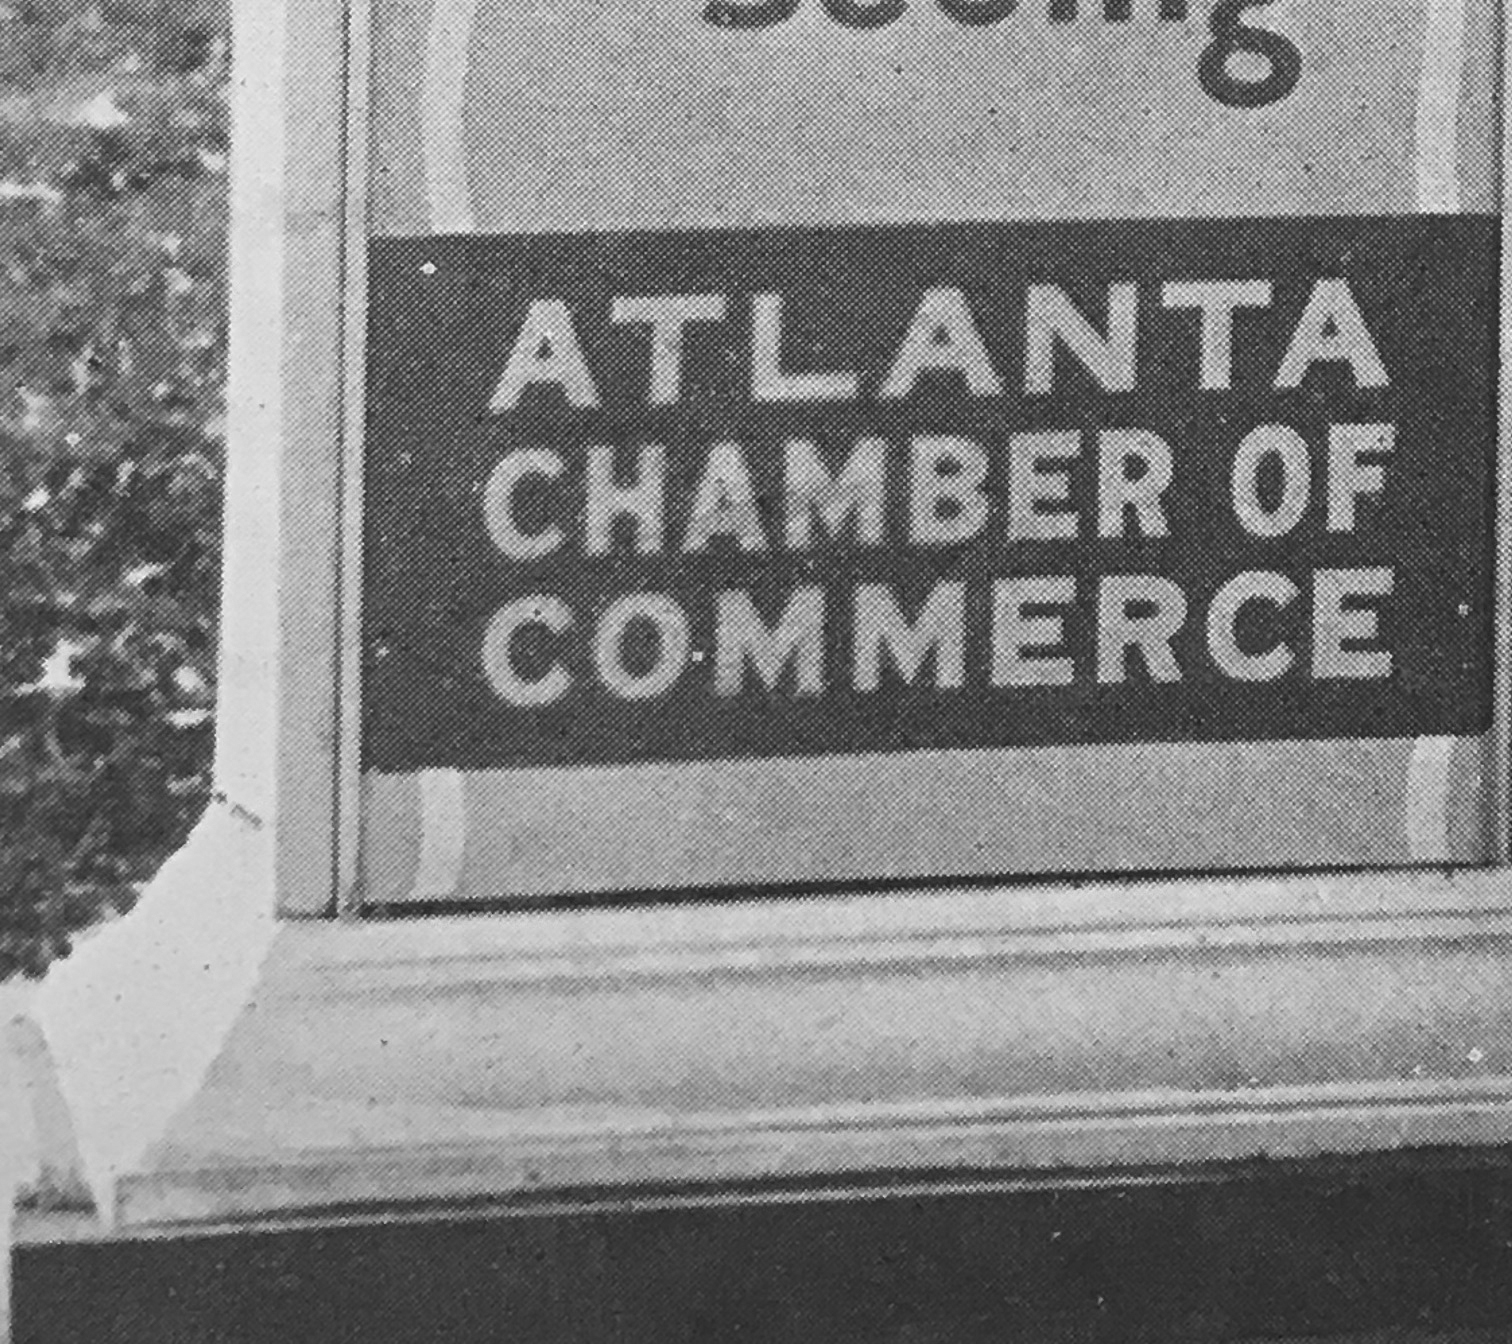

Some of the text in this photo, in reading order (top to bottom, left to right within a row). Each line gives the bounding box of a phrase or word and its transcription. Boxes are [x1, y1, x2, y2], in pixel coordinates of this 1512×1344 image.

[487, 279, 1391, 412] ATLANTA
[481, 422, 1396, 560] CHAMBER OF
[480, 567, 1396, 707] COMMERCE
